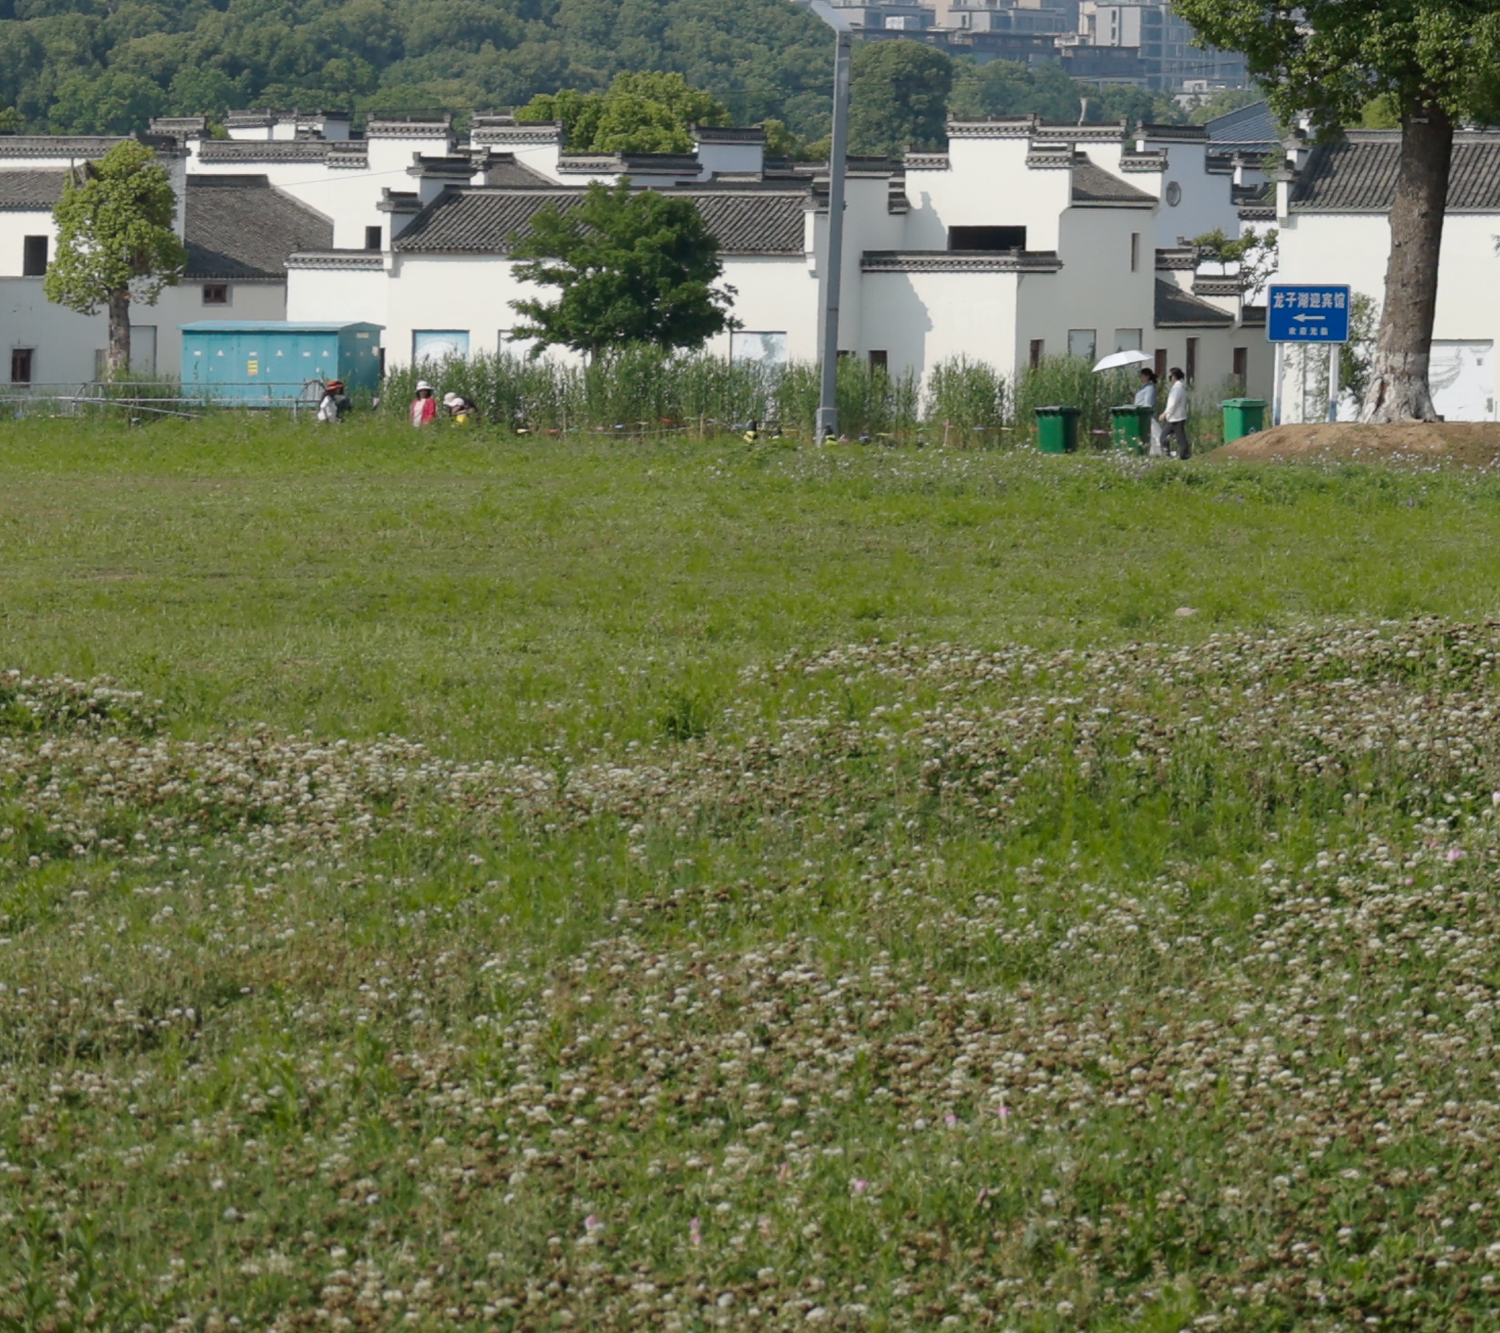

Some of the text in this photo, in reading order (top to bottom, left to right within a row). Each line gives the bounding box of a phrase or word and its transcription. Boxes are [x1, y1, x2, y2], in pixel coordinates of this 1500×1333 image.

[1273, 291, 1346, 309] 龙子湖迎宾馆
